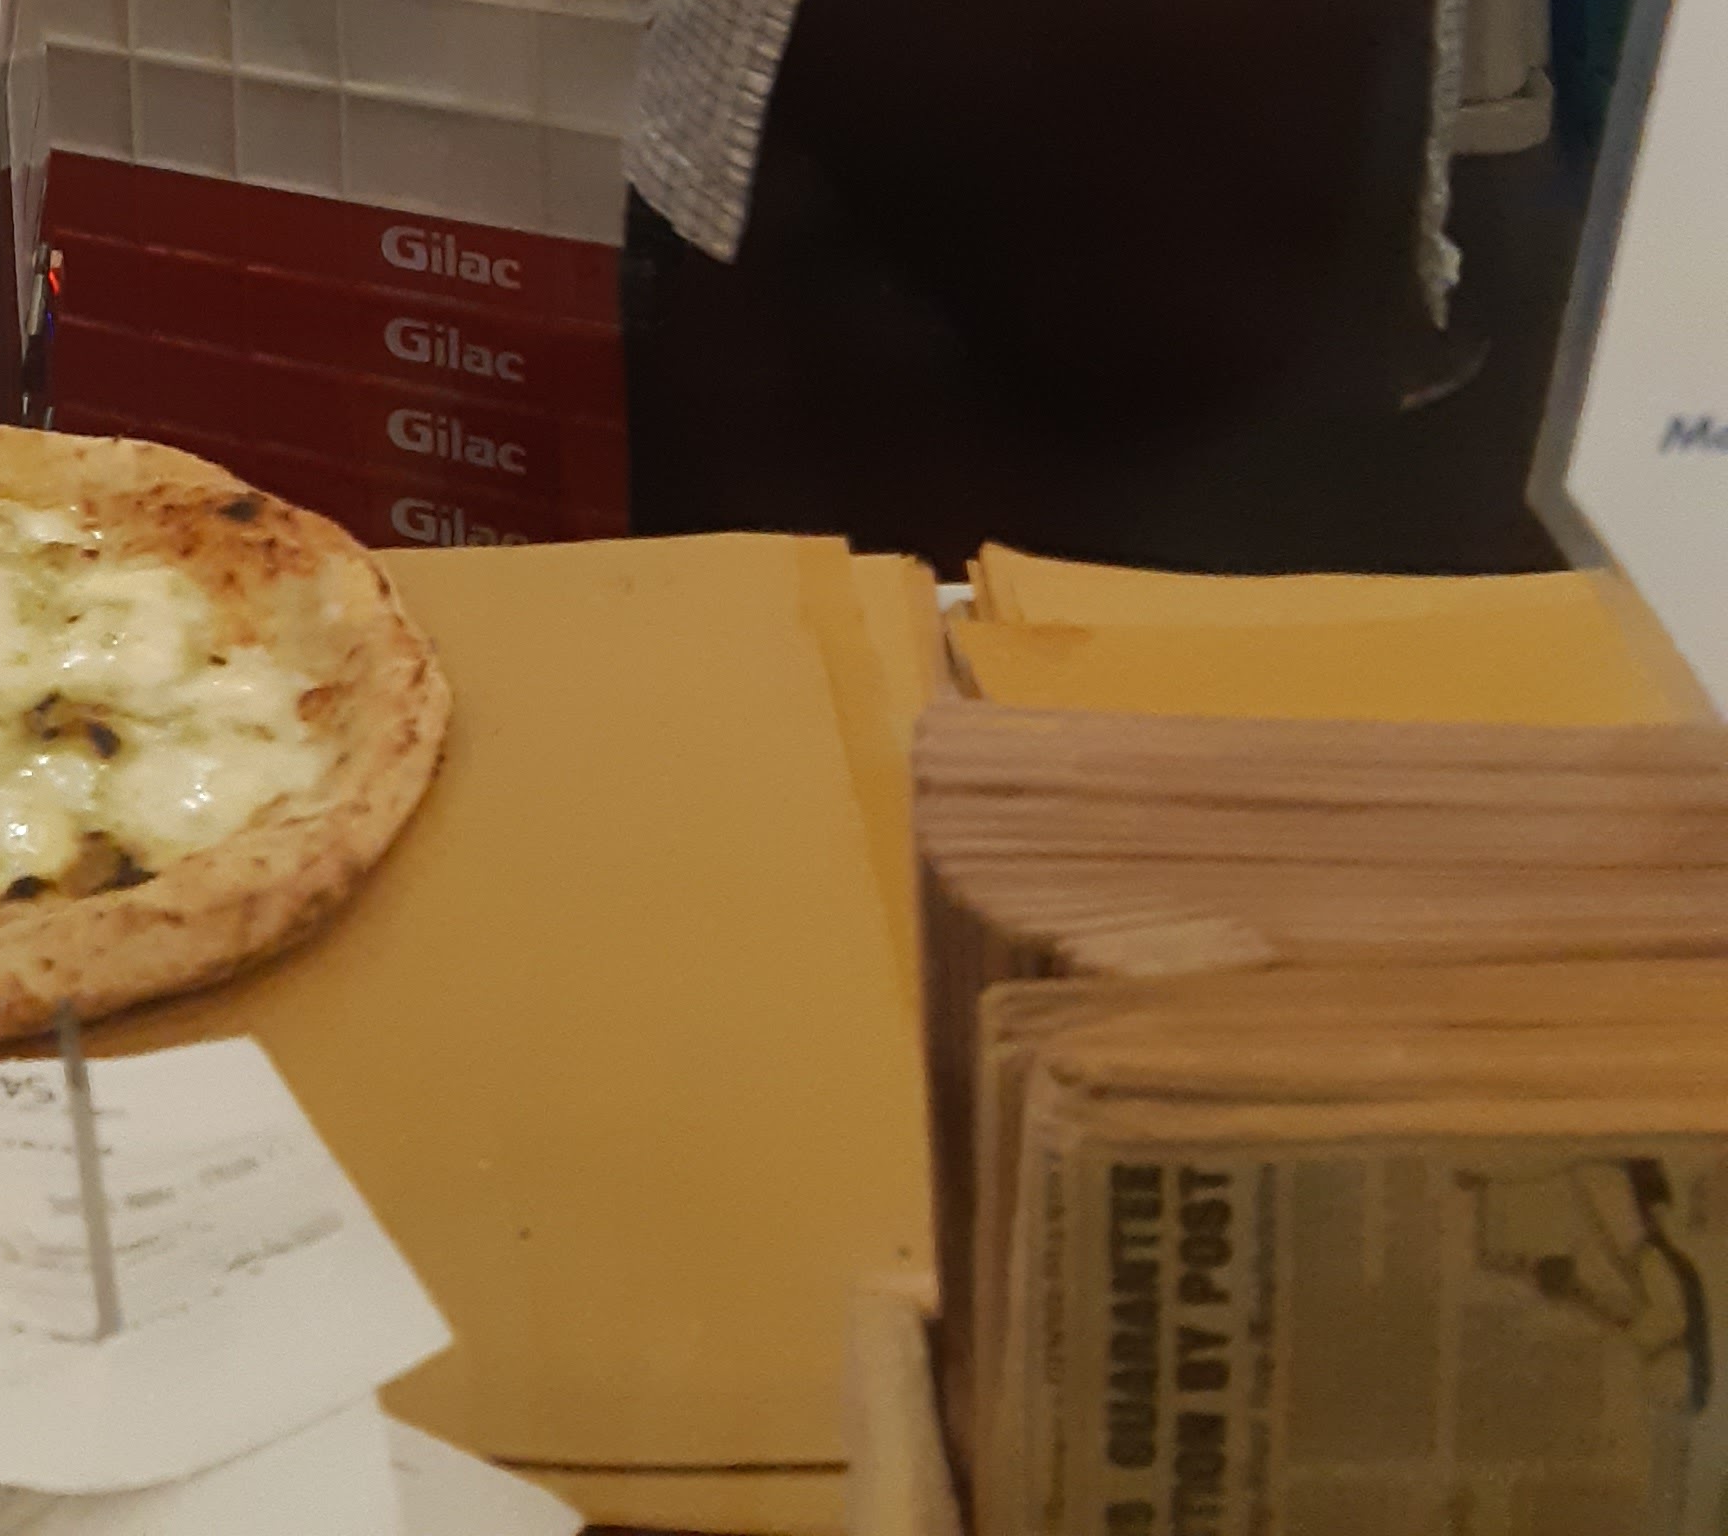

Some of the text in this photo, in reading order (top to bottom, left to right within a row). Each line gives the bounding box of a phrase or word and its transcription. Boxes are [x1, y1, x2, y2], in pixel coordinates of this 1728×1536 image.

[379, 225, 521, 290] Gilac
[383, 317, 525, 383] Gilac
[386, 408, 528, 476] Gilac
[1176, 1165, 1235, 1306] POST
